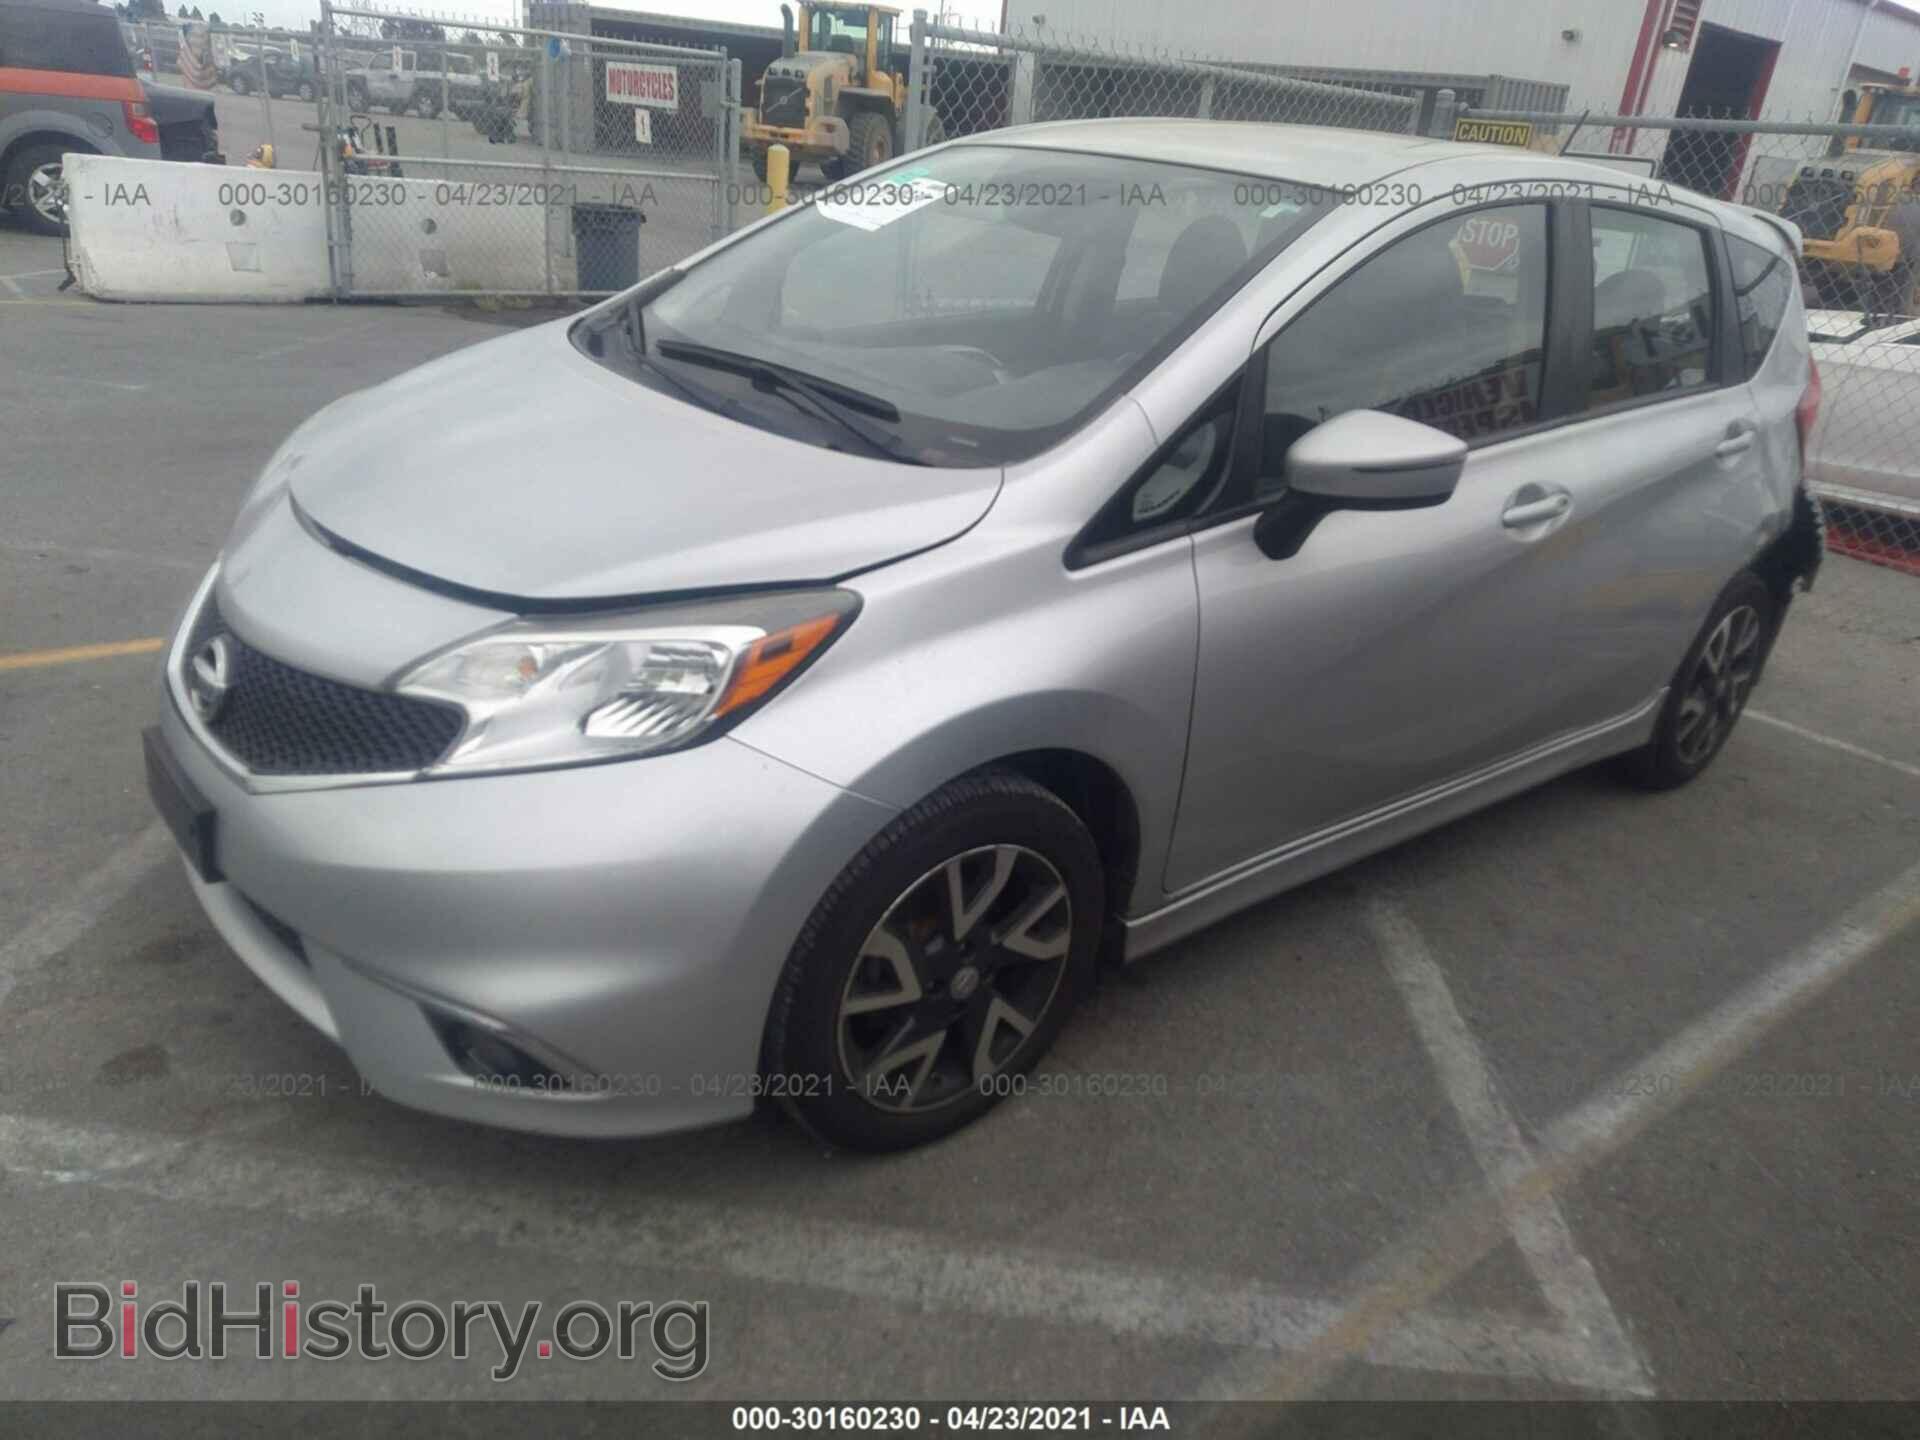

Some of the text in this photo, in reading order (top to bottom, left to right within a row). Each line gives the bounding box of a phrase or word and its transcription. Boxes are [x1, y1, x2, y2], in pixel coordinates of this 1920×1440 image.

[607, 68, 675, 101] MOTORCYCLES
[1458, 123, 1527, 146] CAUTION
[1461, 217, 1519, 249] STOP
